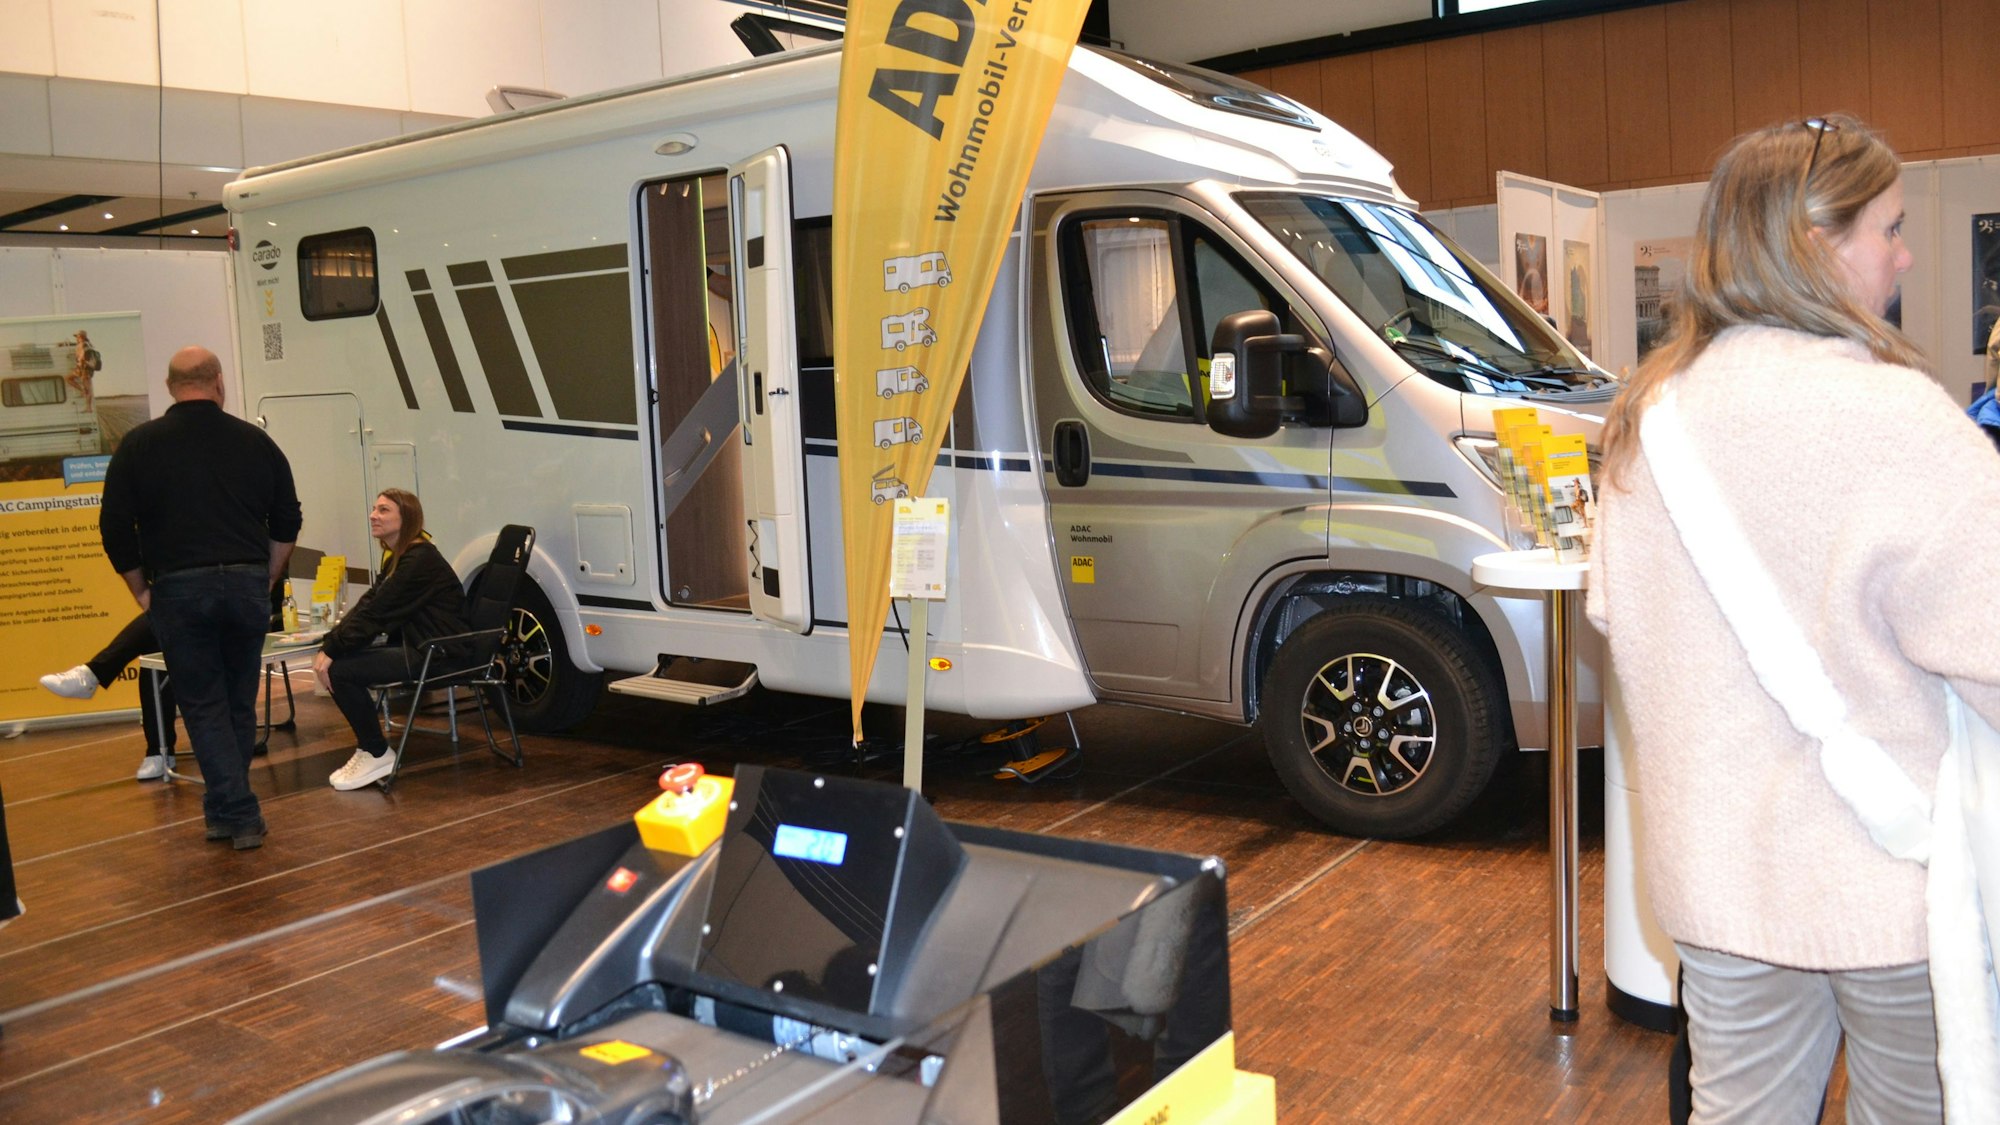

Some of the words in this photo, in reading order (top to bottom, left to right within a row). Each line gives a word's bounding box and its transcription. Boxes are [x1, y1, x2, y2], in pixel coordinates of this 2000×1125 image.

[868, 0, 988, 141] AD
[934, 0, 1034, 222] Wohnmobil-Ver
[252, 245, 281, 262] carado
[17, 495, 102, 511] Campingstati
[12, 527, 60, 537] vorbereitet
[72, 524, 88, 533] den
[1071, 535, 1112, 543] Wohnmobil
[28, 543, 67, 551] Wohnwagen
[1072, 558, 1093, 567] ADAC
[42, 611, 109, 623] adac-nordrhein.de
